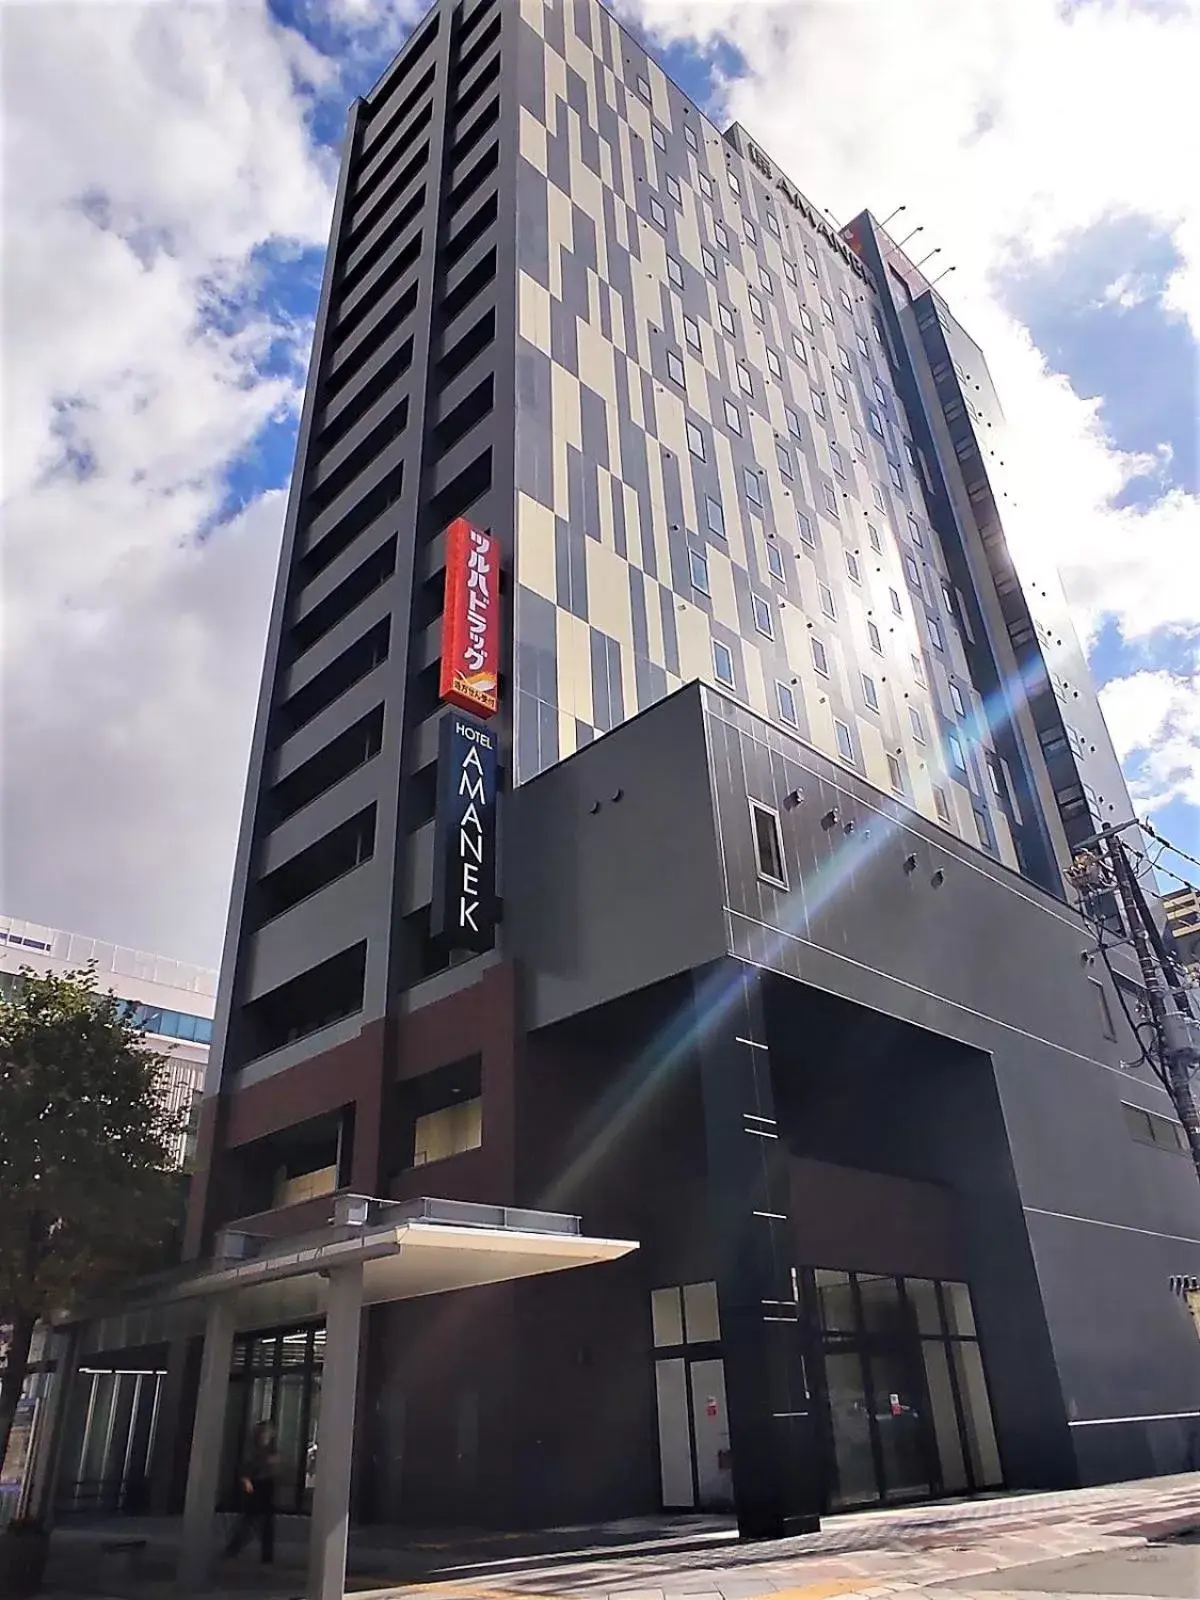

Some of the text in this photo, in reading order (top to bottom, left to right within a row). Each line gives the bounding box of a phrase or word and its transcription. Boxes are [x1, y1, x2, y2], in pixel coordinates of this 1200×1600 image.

[464, 530, 490, 671] ツルハドラッグ
[455, 722, 493, 750] HOTEL
[459, 746, 486, 932] AMANEK
